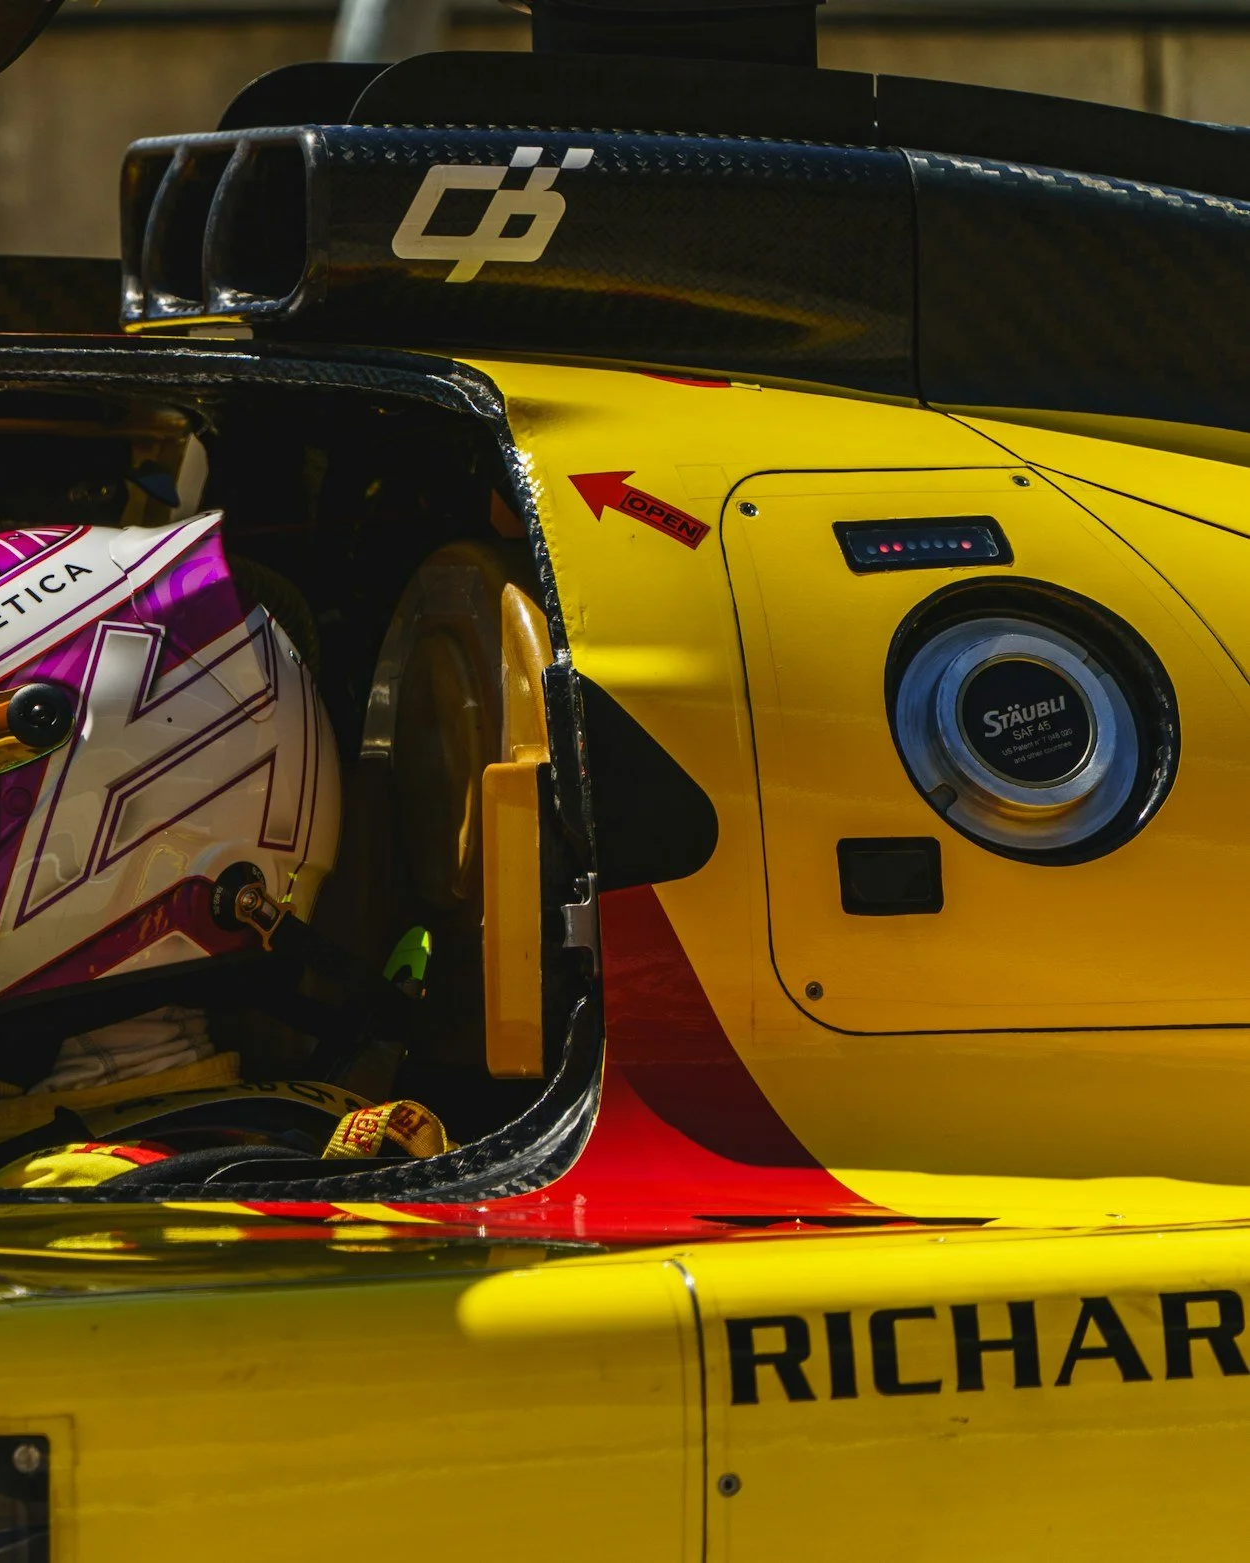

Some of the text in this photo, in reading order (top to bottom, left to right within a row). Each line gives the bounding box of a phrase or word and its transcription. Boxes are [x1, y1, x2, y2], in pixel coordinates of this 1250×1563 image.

[628, 497, 698, 538] OPEN
[1012, 721, 1051, 740] SAF 45
[724, 1288, 1250, 1406] RICHAR
